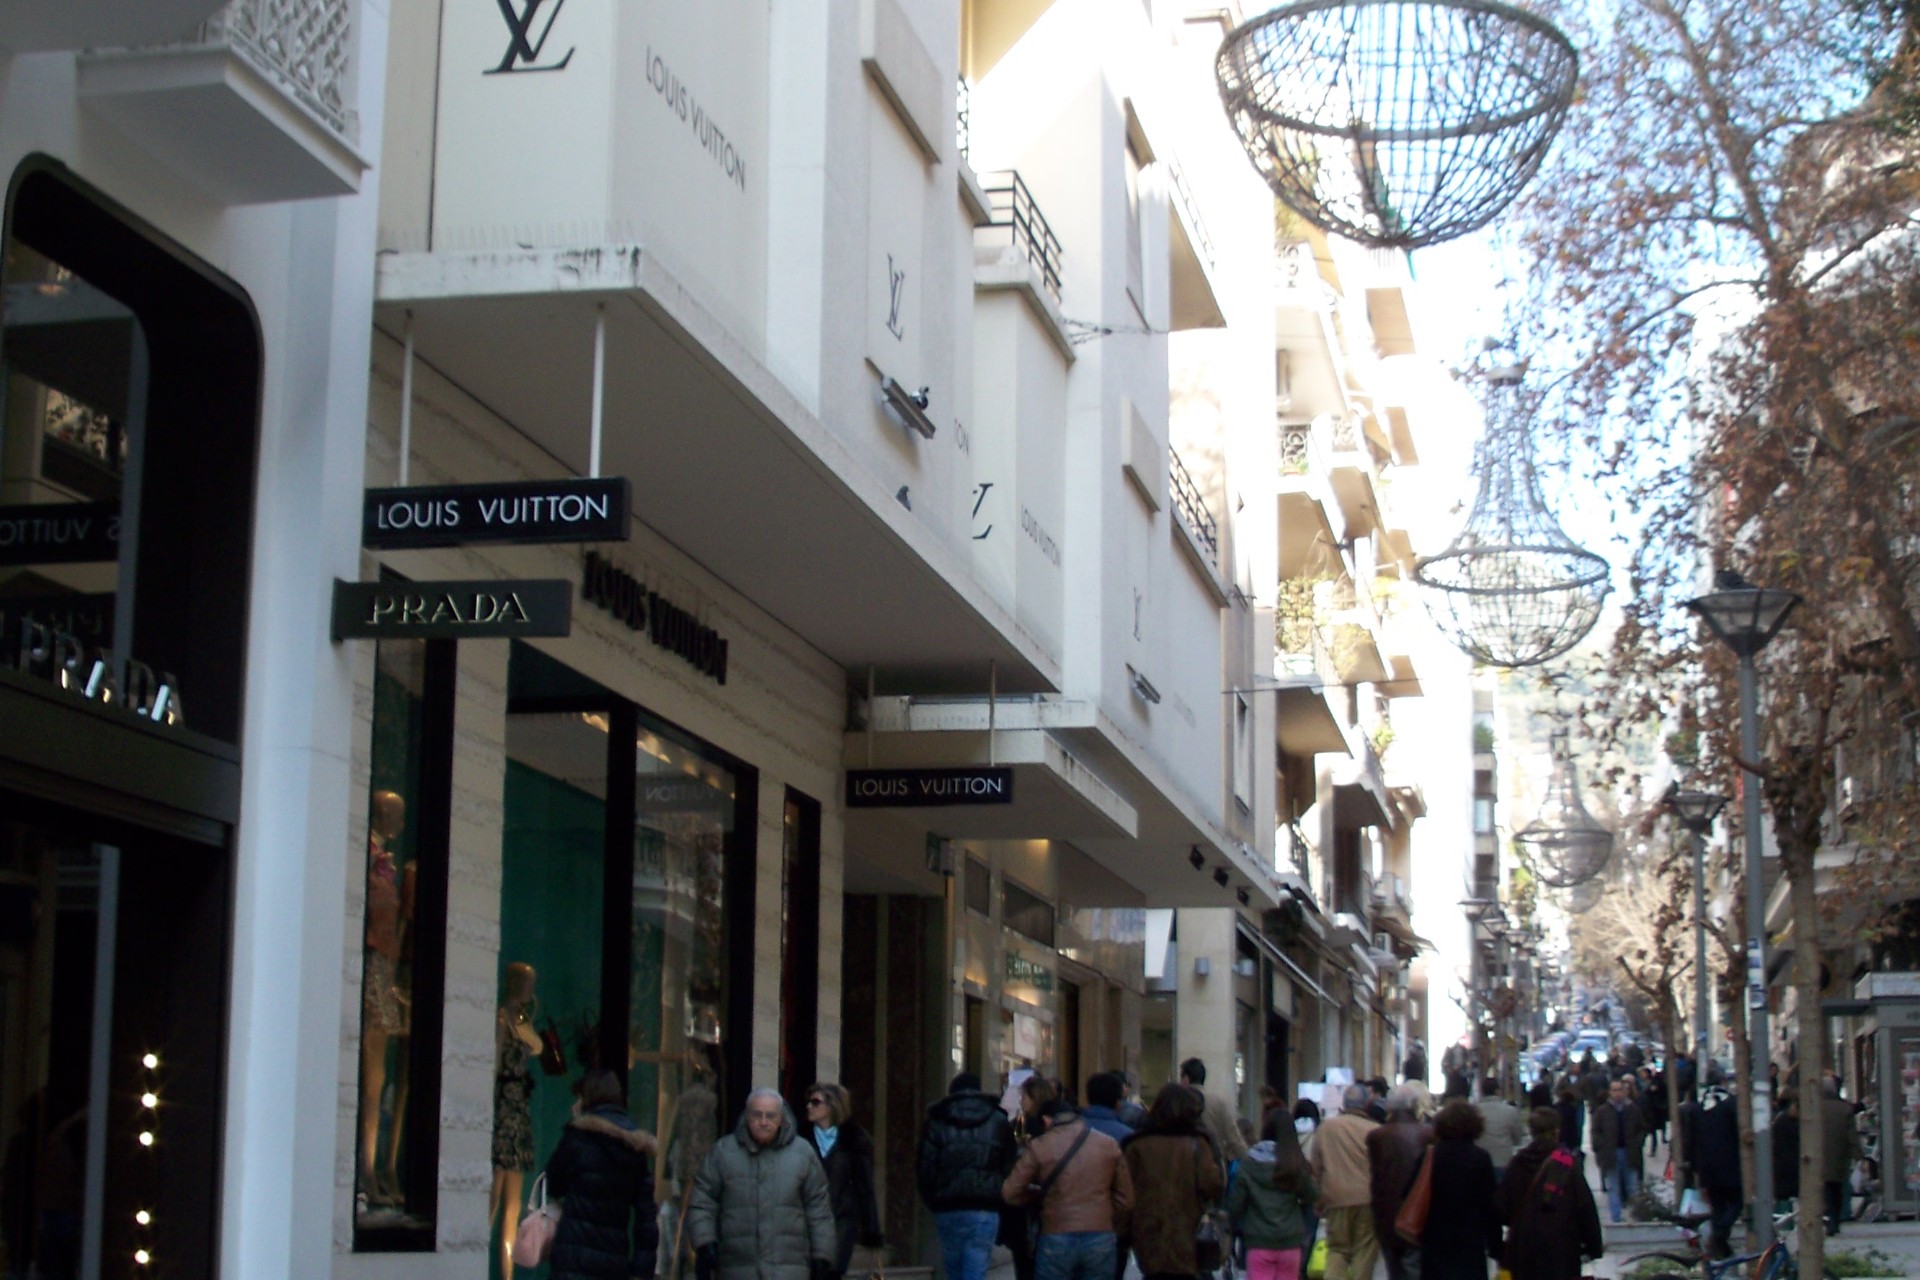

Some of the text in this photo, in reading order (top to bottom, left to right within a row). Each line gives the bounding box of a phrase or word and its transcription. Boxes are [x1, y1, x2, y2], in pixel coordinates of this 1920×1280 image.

[645, 45, 746, 193] LOUIS VUITTON
[377, 493, 608, 530] LOUIS VUITTON
[366, 591, 531, 624] PRADA
[19, 615, 187, 730] PRADA
[855, 776, 1003, 797] LOUIS VUITTON
